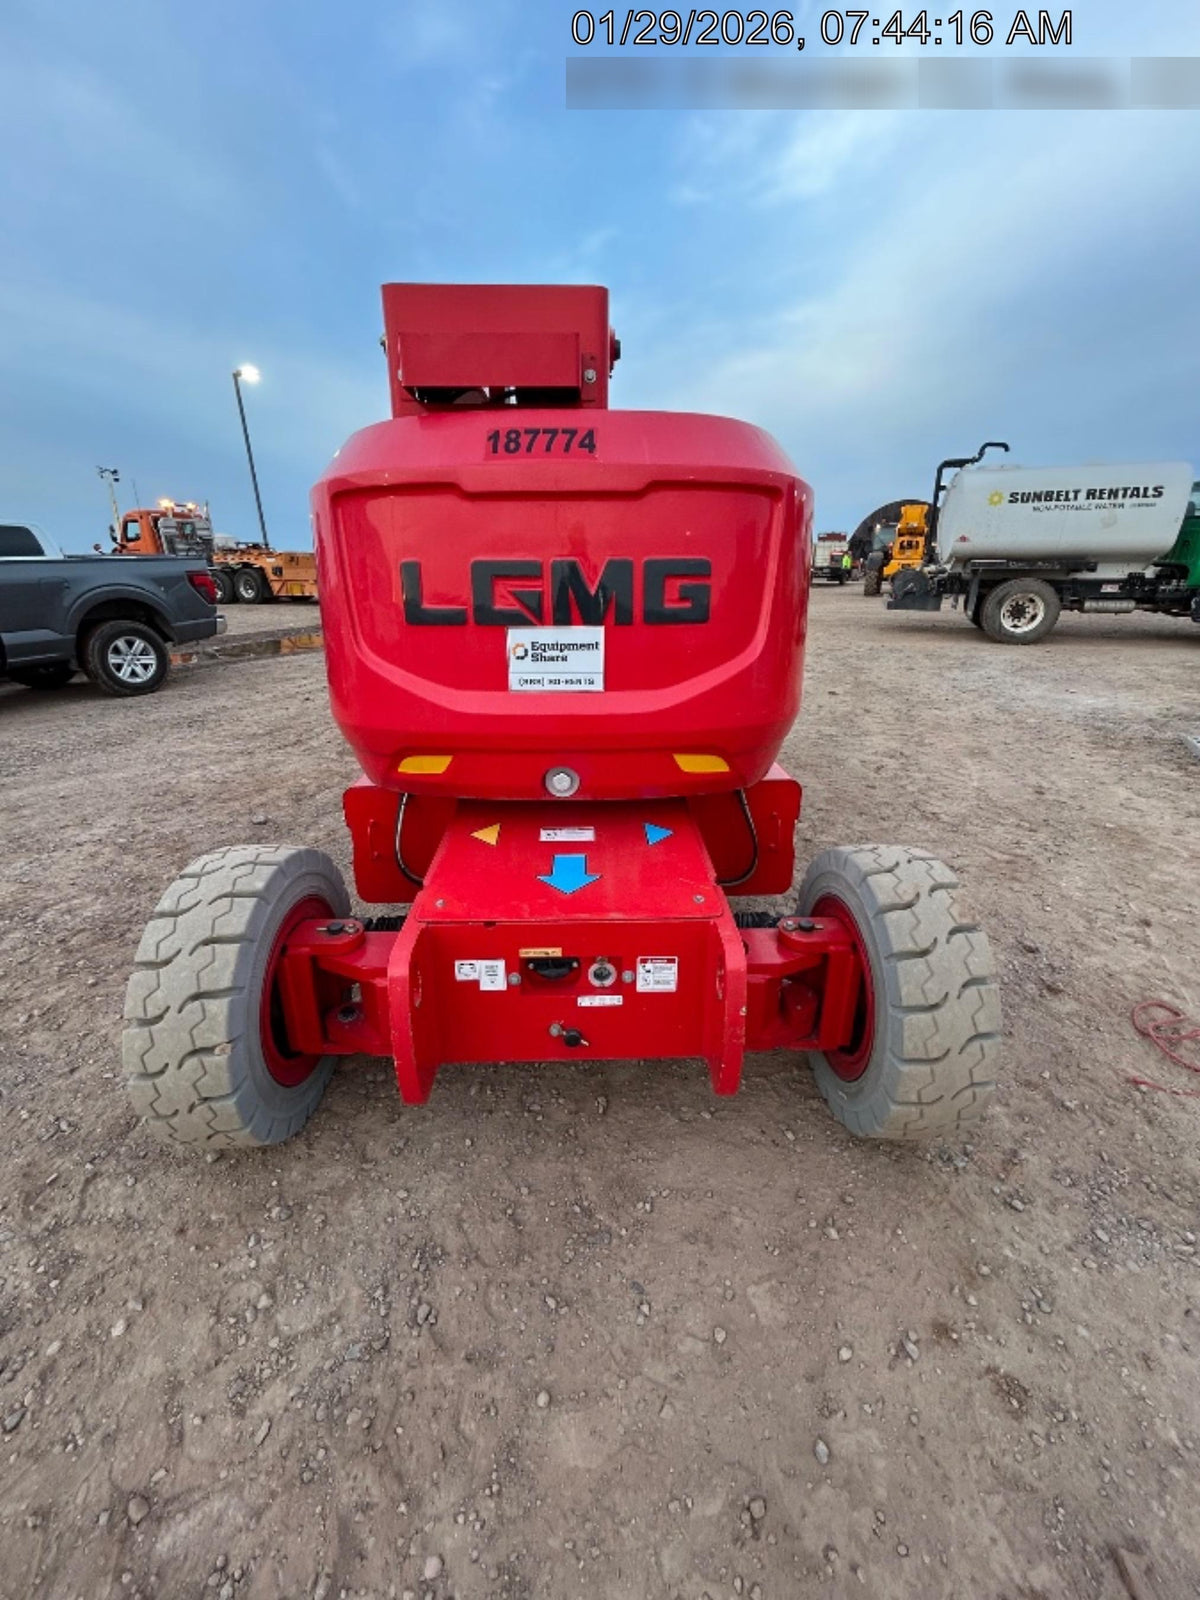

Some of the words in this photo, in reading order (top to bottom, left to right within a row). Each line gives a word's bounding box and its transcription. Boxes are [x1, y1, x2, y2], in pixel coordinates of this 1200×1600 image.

[487, 428, 596, 454] 187774
[1008, 489, 1081, 504] SUNBELT
[1086, 485, 1165, 500] RENTALS
[1095, 502, 1125, 510] WATER
[400, 557, 711, 626] LGMG
[530, 641, 600, 653] Equipment
[530, 652, 568, 662] Share
